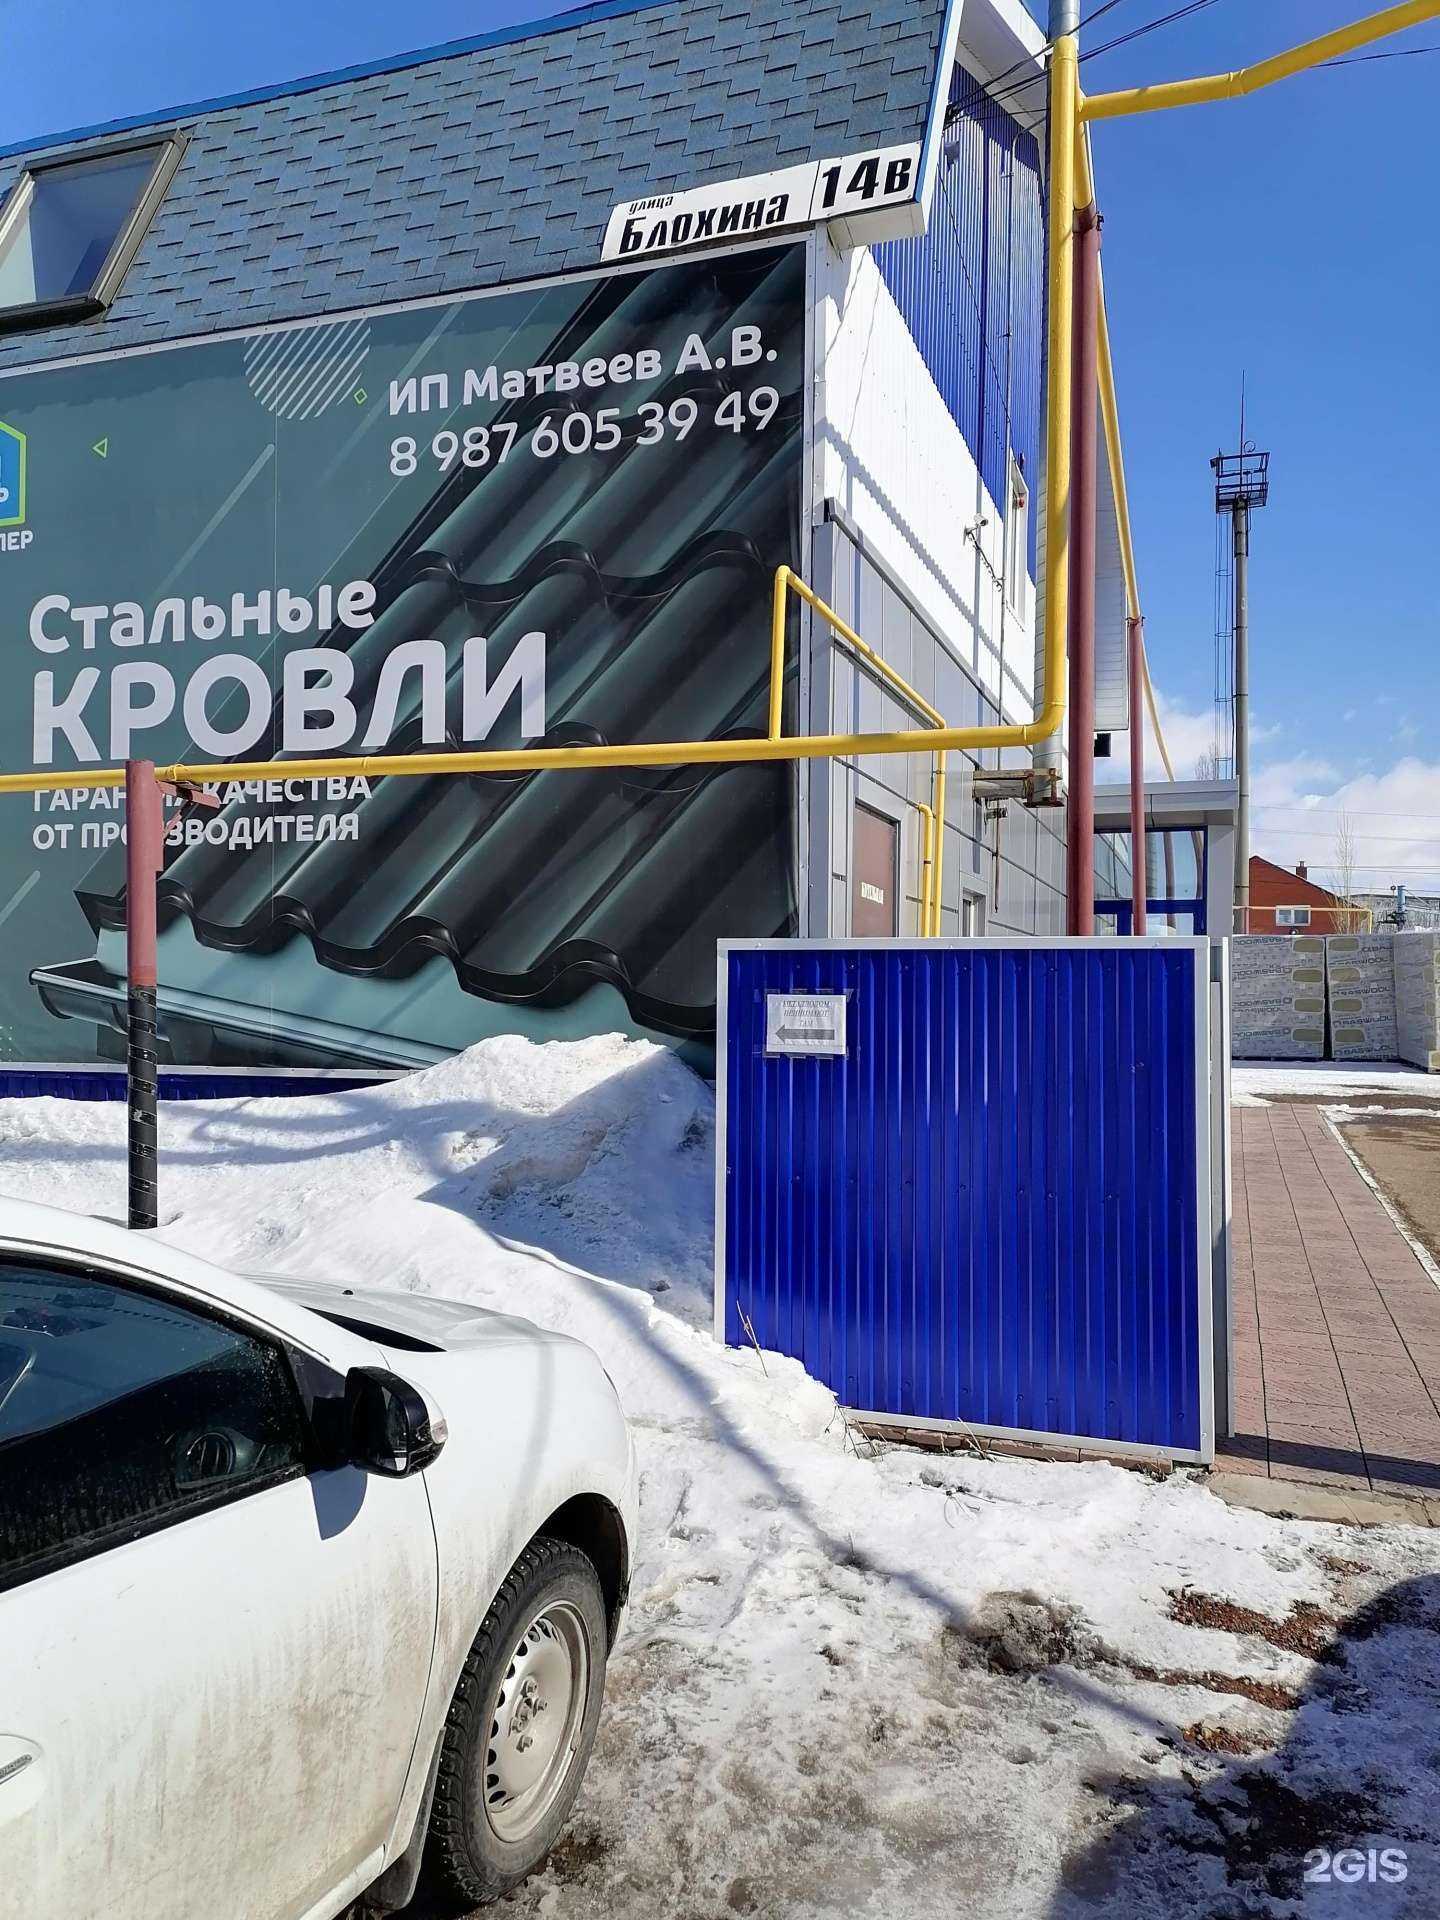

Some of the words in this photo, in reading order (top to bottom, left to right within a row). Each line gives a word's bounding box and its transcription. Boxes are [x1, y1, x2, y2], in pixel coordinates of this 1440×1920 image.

[619, 194, 790, 254] Блохина
[629, 195, 673, 214] улица
[389, 374, 448, 416] ИП
[463, 349, 661, 406] Матвеев
[675, 325, 778, 376] А.В.
[389, 437, 417, 476] 8
[432, 423, 518, 472] 987
[531, 408, 622, 458] 605
[637, 398, 699, 445] 39
[714, 386, 780, 432] 49
[29, 579, 377, 654] Стальные
[33, 631, 546, 764] КРОВЛИ
[33, 824, 74, 850] ОТ
[82, 813, 359, 850] ПРЗВОДИТЕЛЯ
